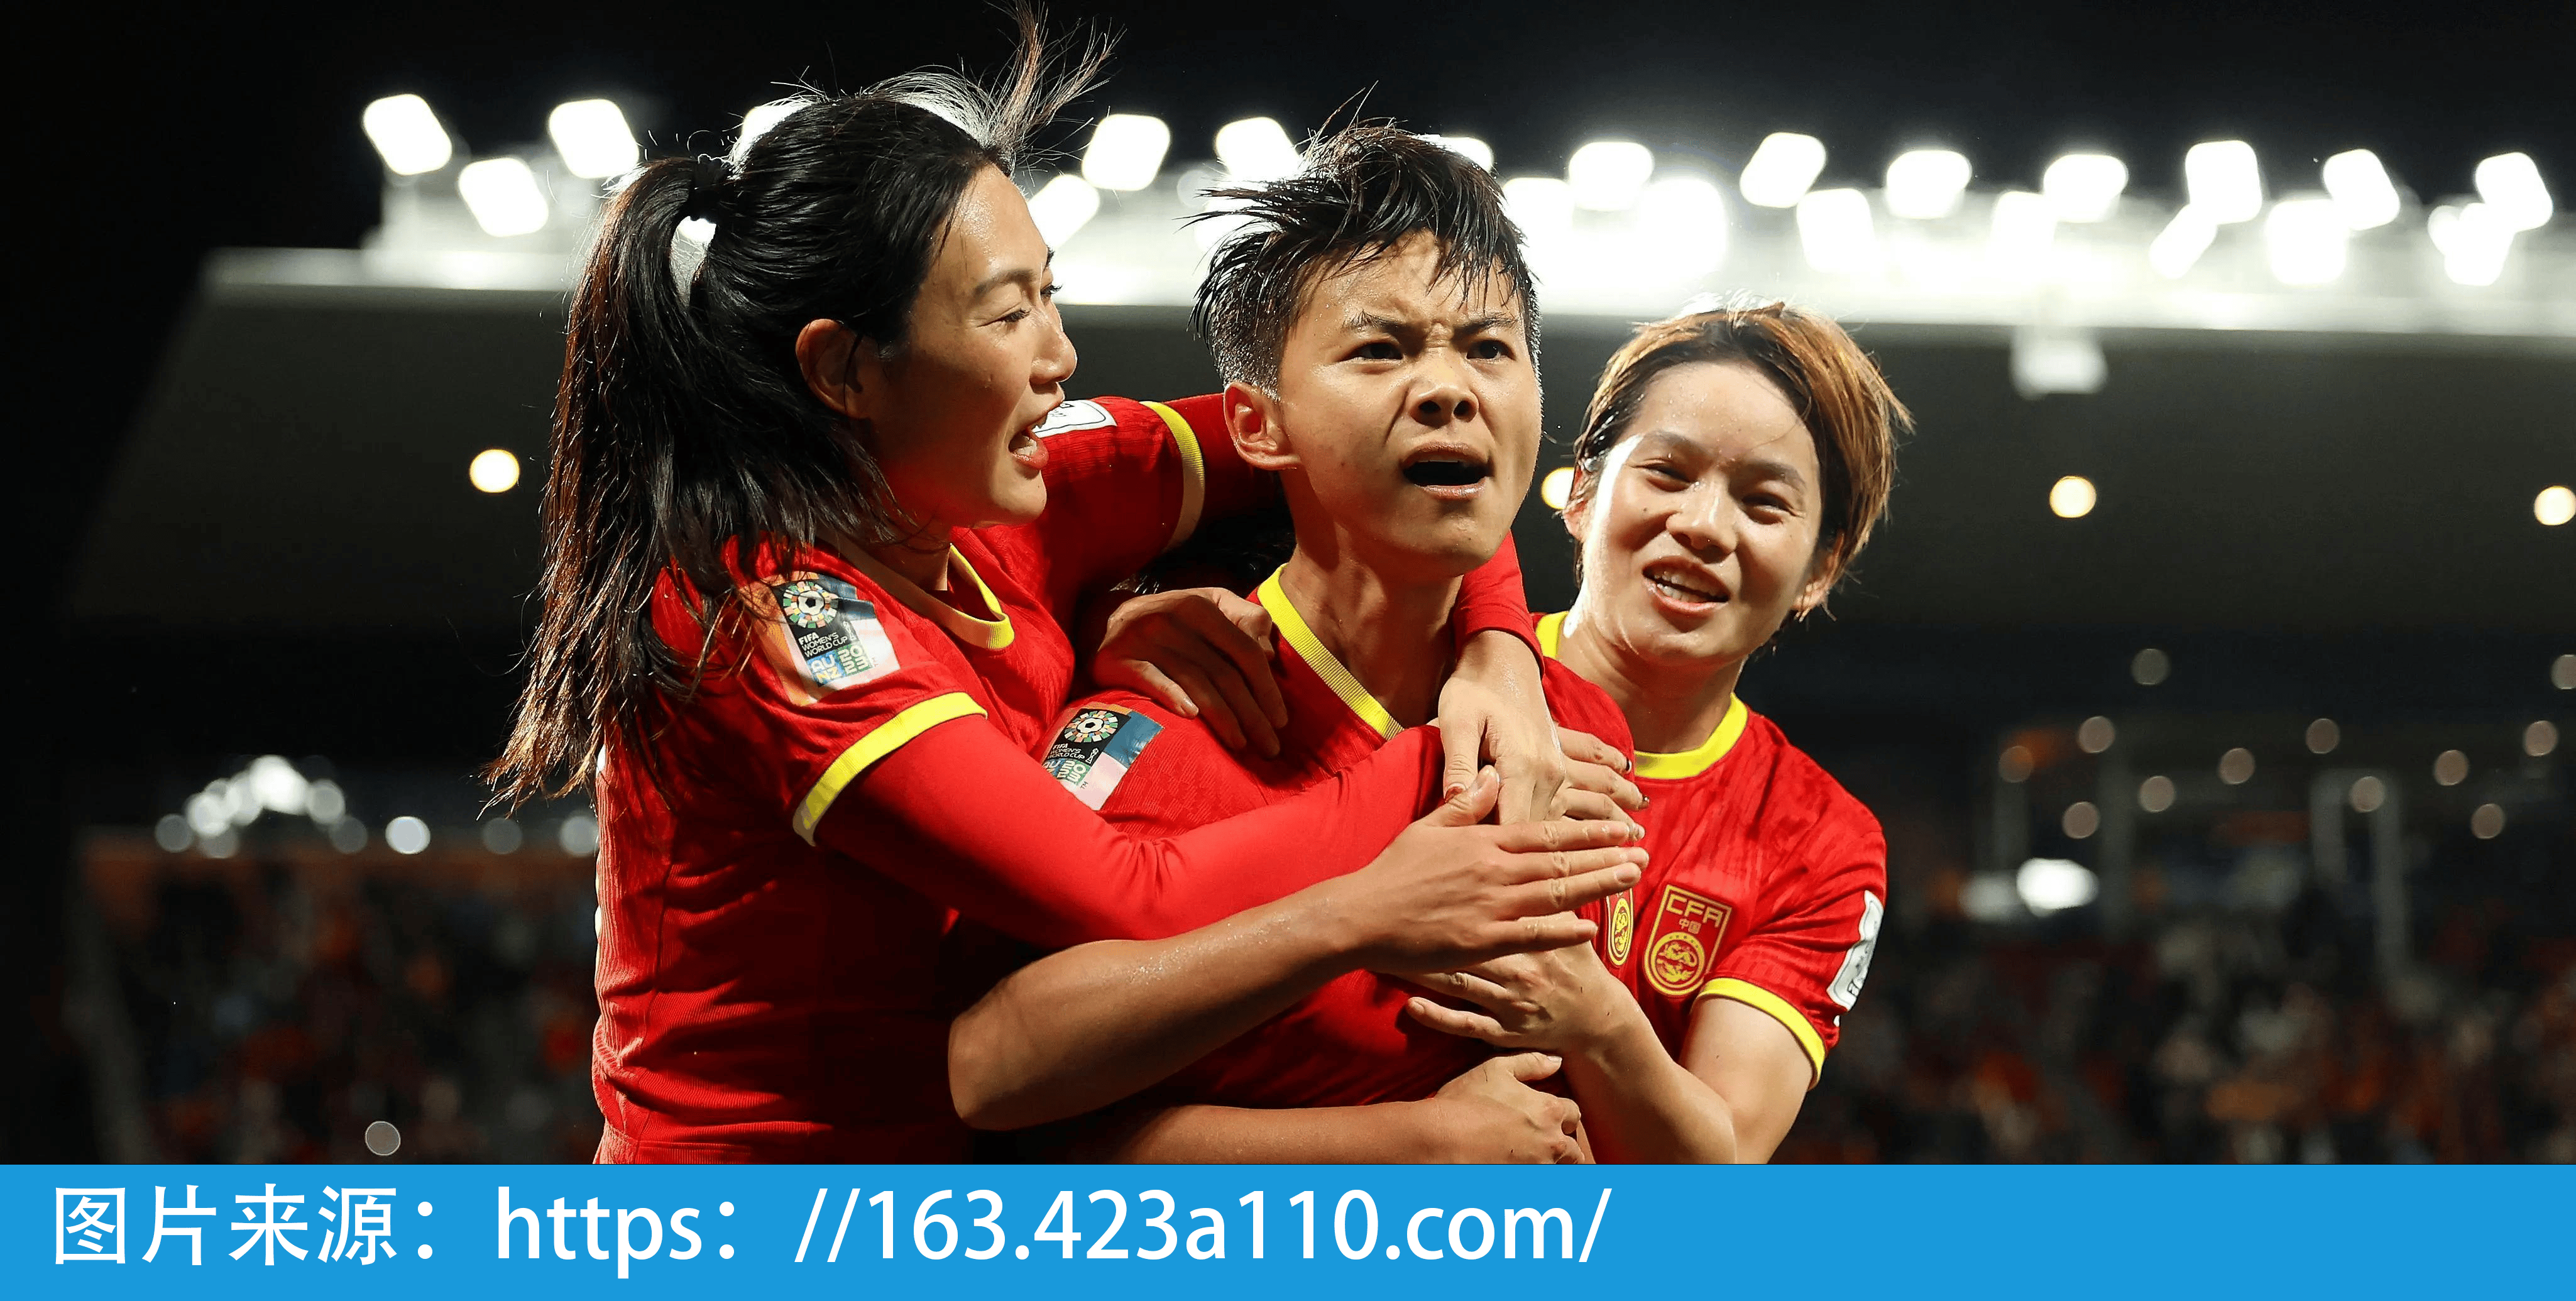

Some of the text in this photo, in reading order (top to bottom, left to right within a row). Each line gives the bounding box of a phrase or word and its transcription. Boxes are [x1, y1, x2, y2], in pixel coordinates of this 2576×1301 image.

[798, 632, 819, 645] FIFA
[802, 632, 839, 651] WOMEN'S
[804, 636, 848, 657] WORLD CUP
[811, 654, 836, 672] AU
[816, 667, 841, 684] NZ
[1666, 893, 1724, 928] CFA
